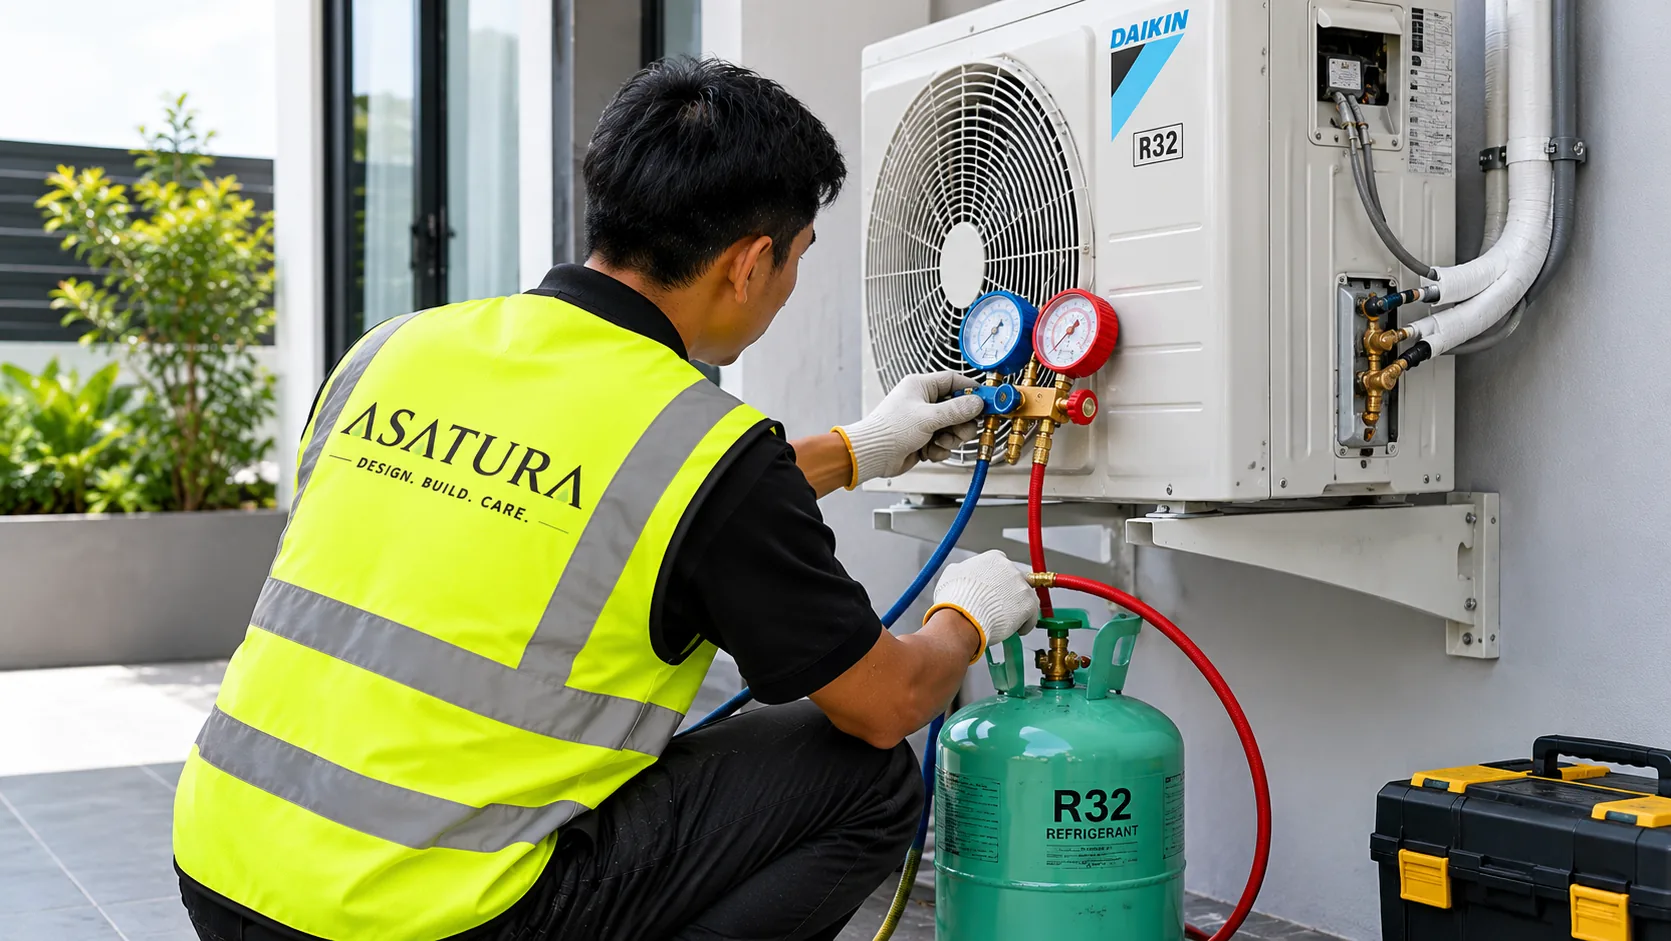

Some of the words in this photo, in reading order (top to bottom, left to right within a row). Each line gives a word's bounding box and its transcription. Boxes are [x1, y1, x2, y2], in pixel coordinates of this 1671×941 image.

[1110, 9, 1189, 49] DAIKIN
[1139, 130, 1178, 160] R32
[340, 401, 583, 510] ASATURA
[356, 457, 414, 484] DESIGN.
[421, 476, 472, 502] BUILD.
[480, 496, 529, 523] CARE.
[1053, 788, 1132, 823] R32
[1046, 825, 1139, 840] REFRIGERANT
